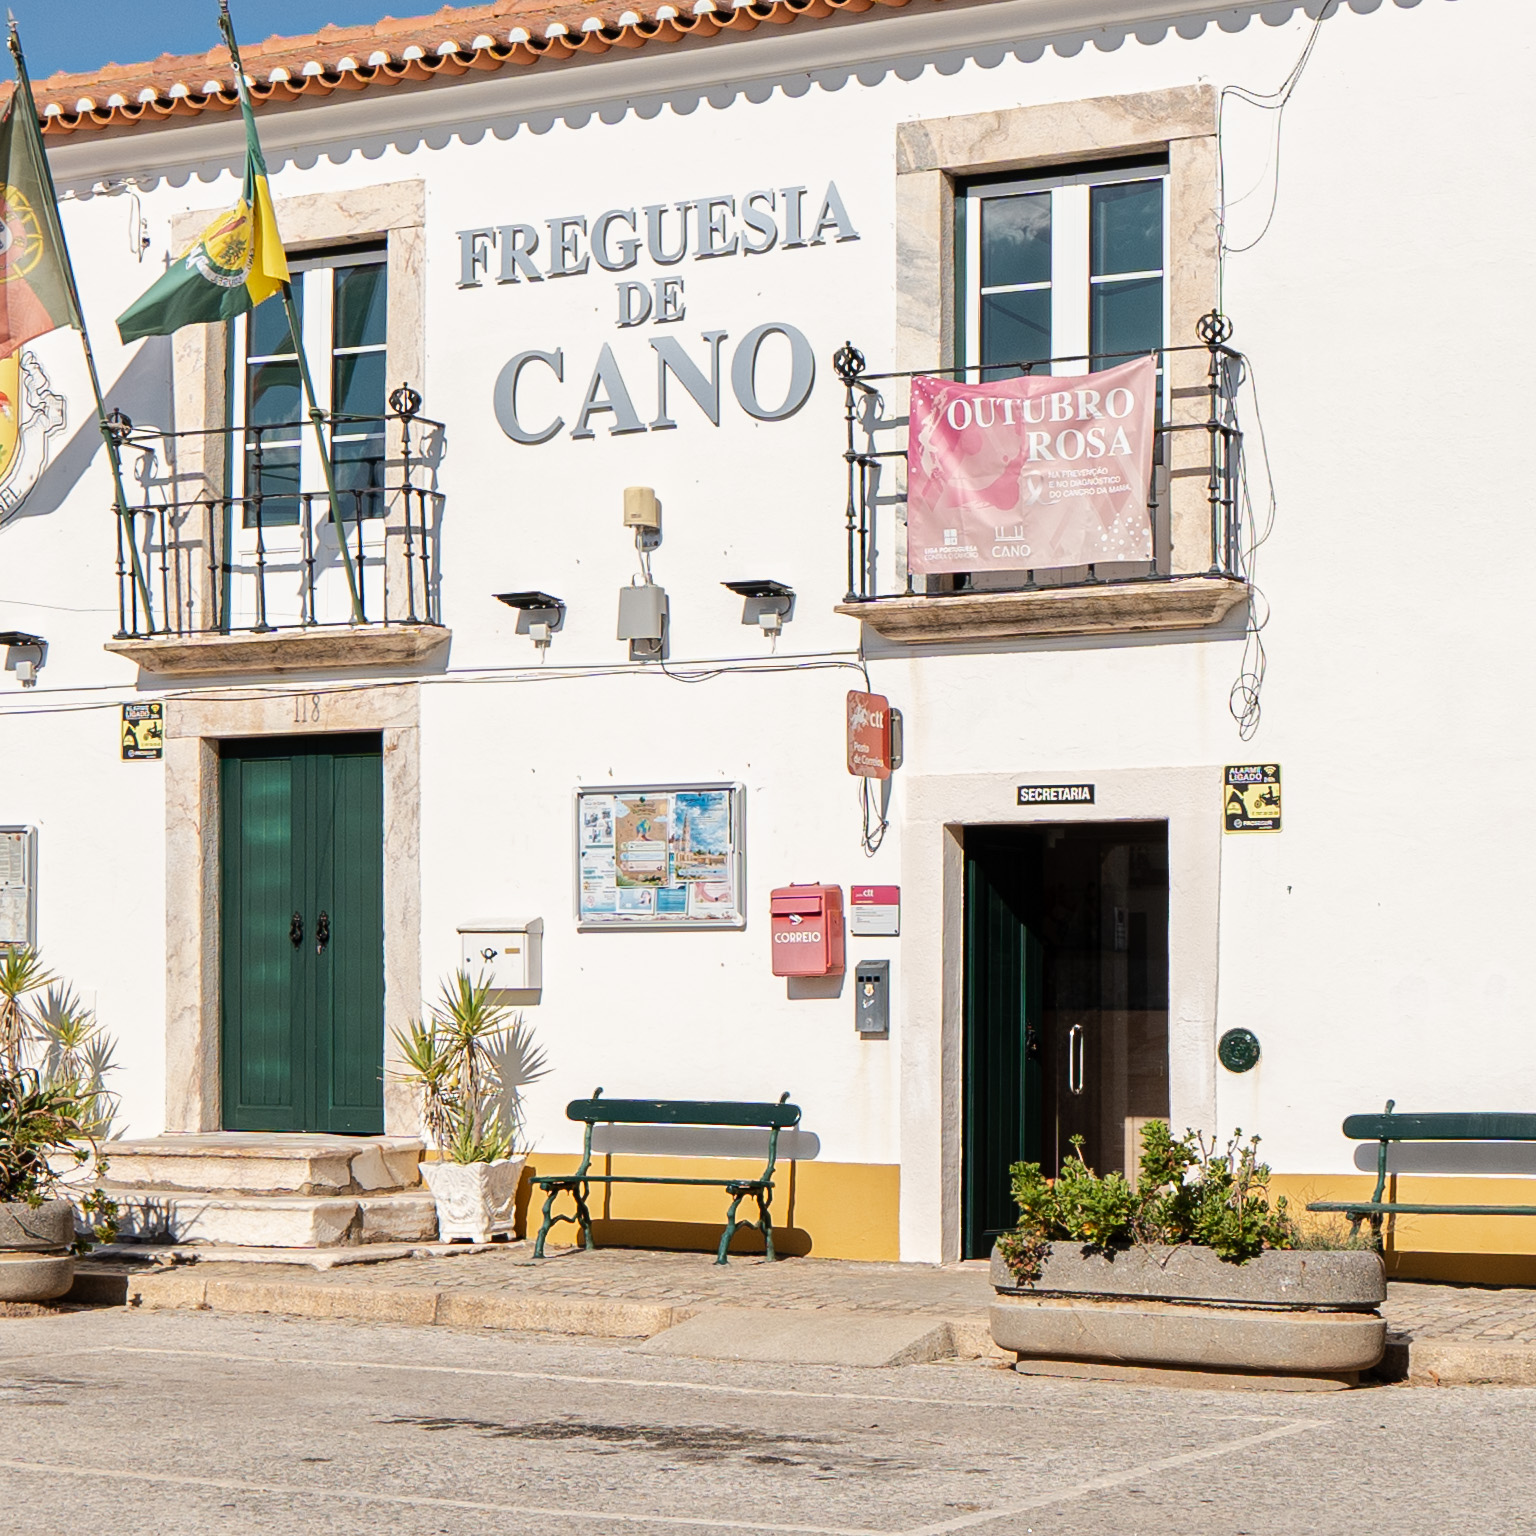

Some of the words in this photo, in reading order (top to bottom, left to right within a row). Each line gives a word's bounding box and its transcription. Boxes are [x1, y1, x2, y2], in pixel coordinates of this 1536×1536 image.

[455, 180, 860, 289] FREGUESIA
[615, 275, 686, 328] DE
[493, 321, 816, 445] CANO
[947, 387, 1135, 431] OUTUBRO
[1027, 427, 1133, 462] ROSA
[992, 544, 1031, 558] CANO
[1229, 773, 1262, 781] LIGADO
[1020, 786, 1091, 802] SECRETARIA
[863, 888, 874, 897] ctt
[774, 931, 821, 943] CORREIO
